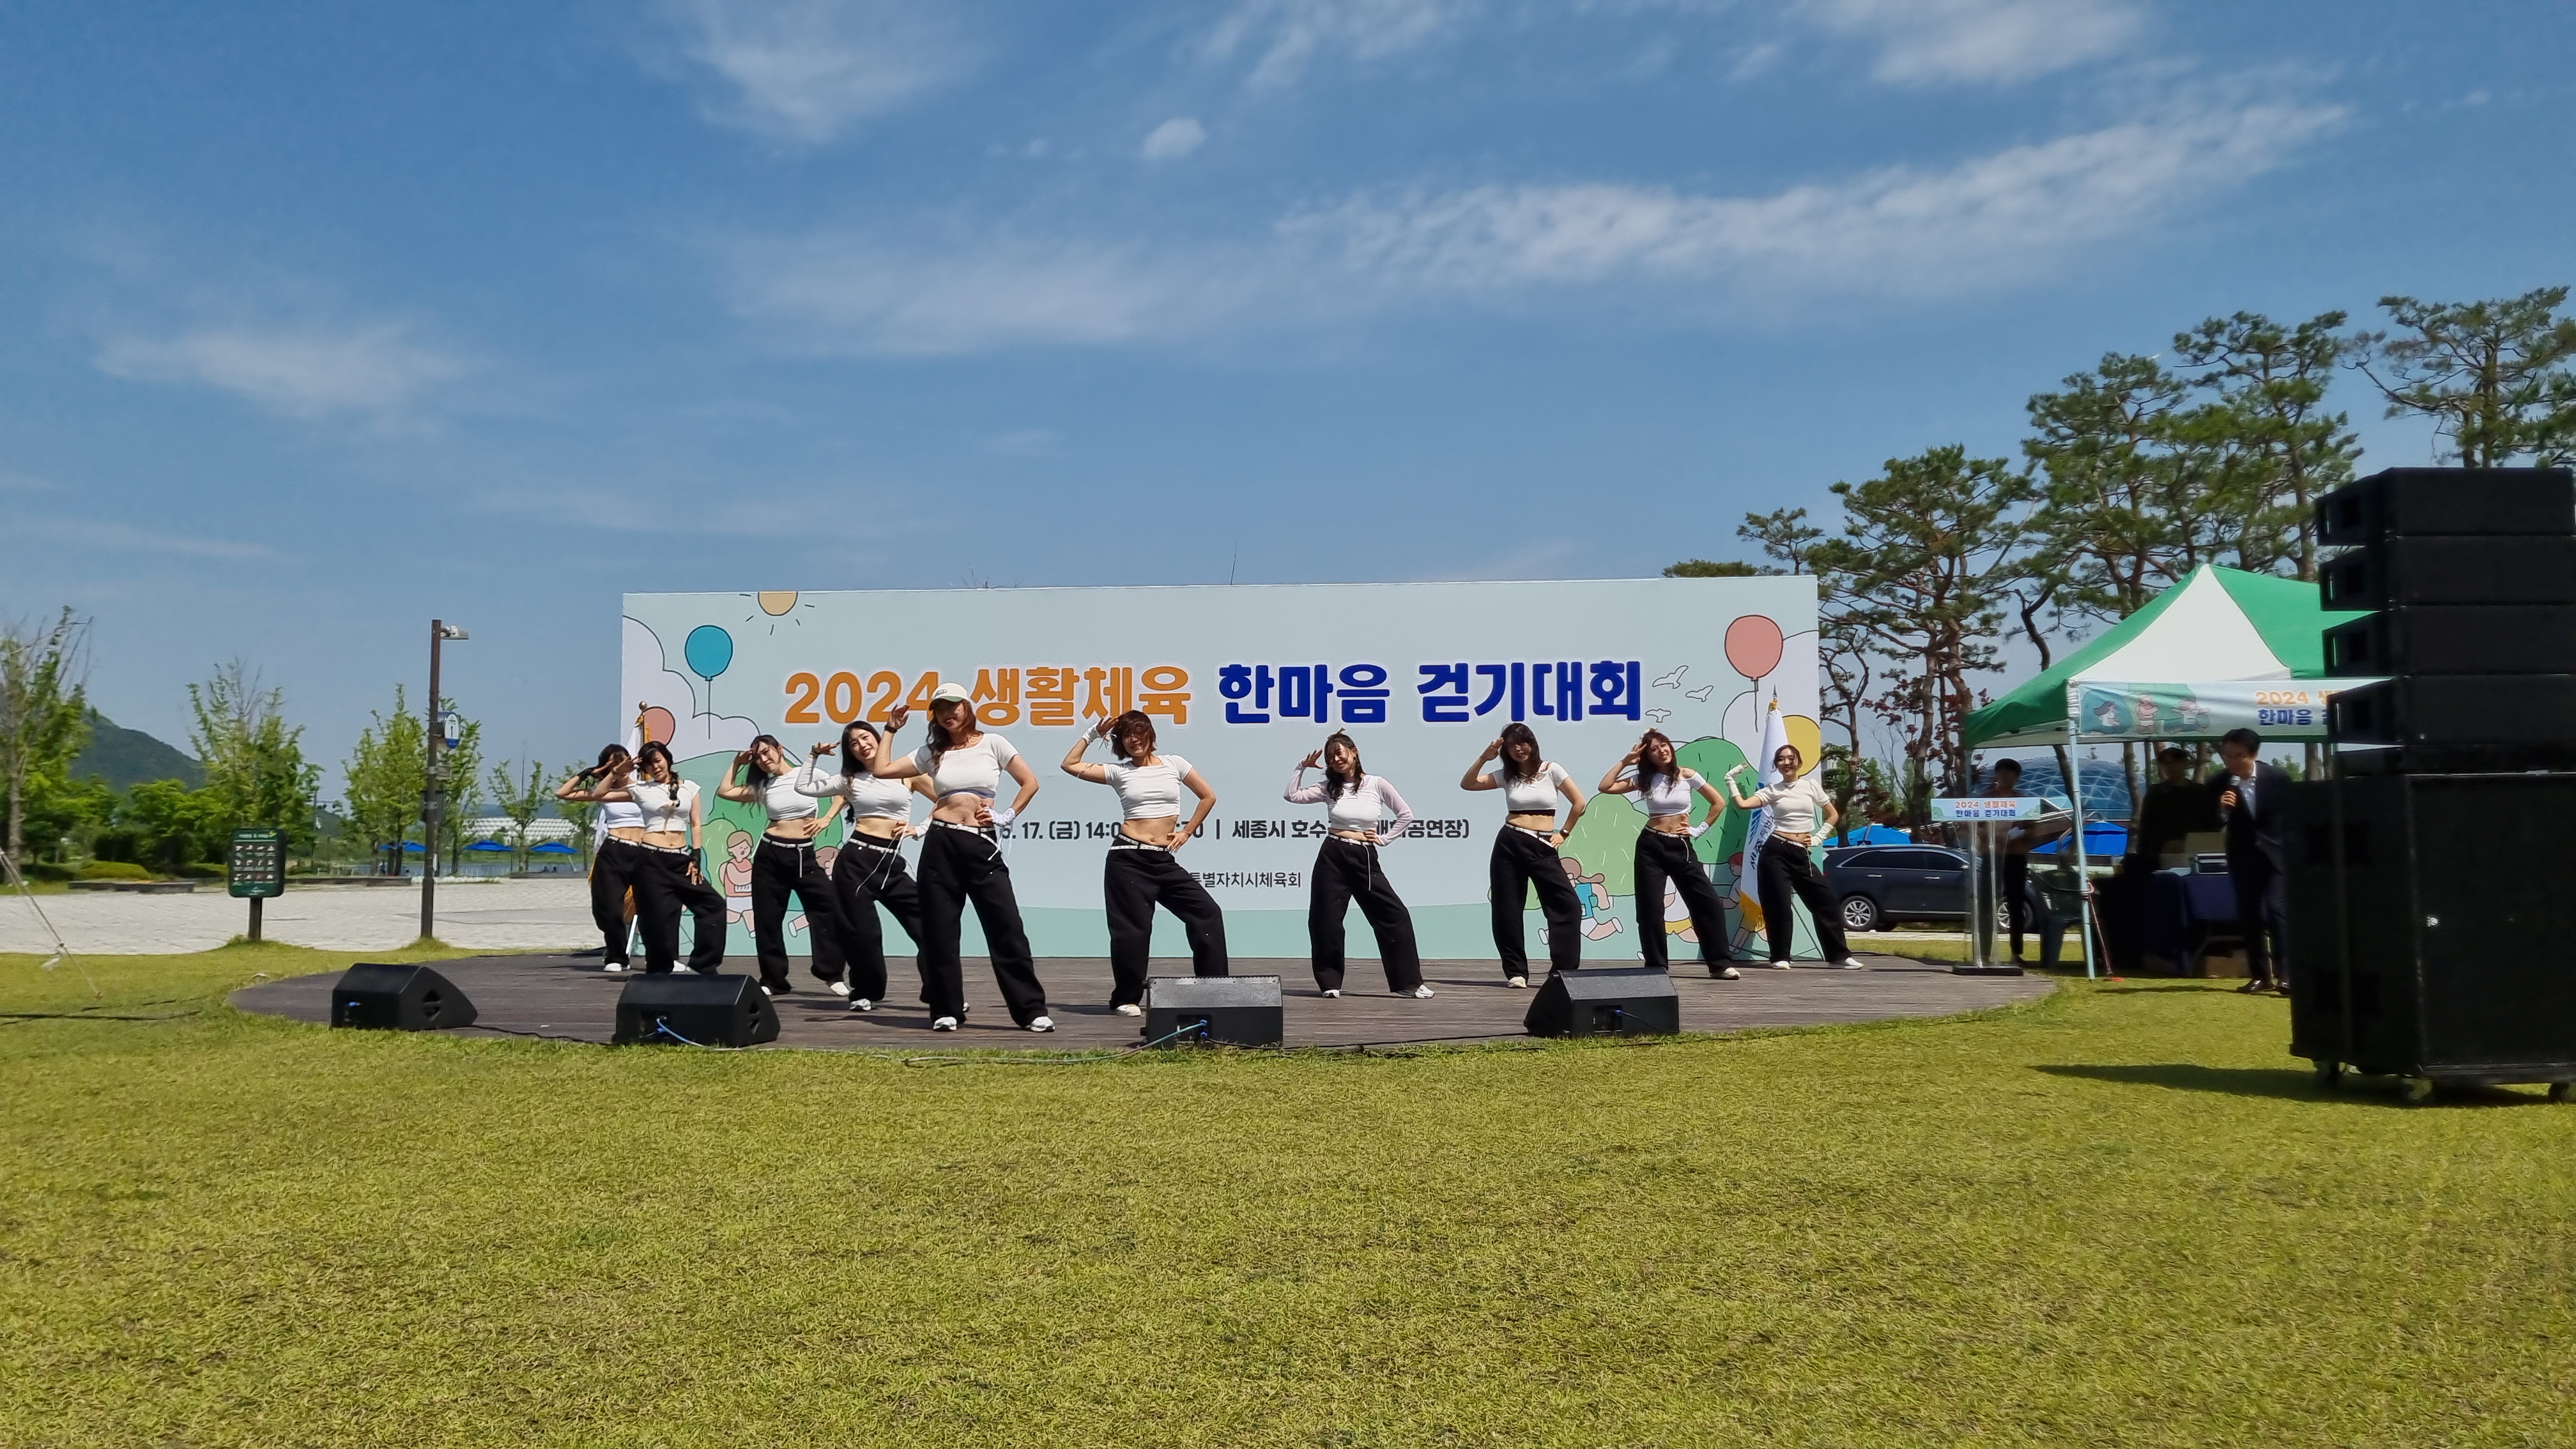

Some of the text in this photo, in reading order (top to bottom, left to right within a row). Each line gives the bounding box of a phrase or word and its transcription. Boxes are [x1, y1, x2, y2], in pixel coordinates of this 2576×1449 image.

[785, 661, 1640, 726] 2024 생활체육 한마음 걷기대회
[2256, 691, 2310, 705] 2024
[2257, 709, 2313, 725] 한마음
[1956, 809, 1980, 818] 한마음
[1022, 822, 1043, 839] 17.
[1049, 820, 1080, 840] (금)
[1085, 822, 1122, 839] 14:0
[1232, 820, 1285, 839] 세종시
